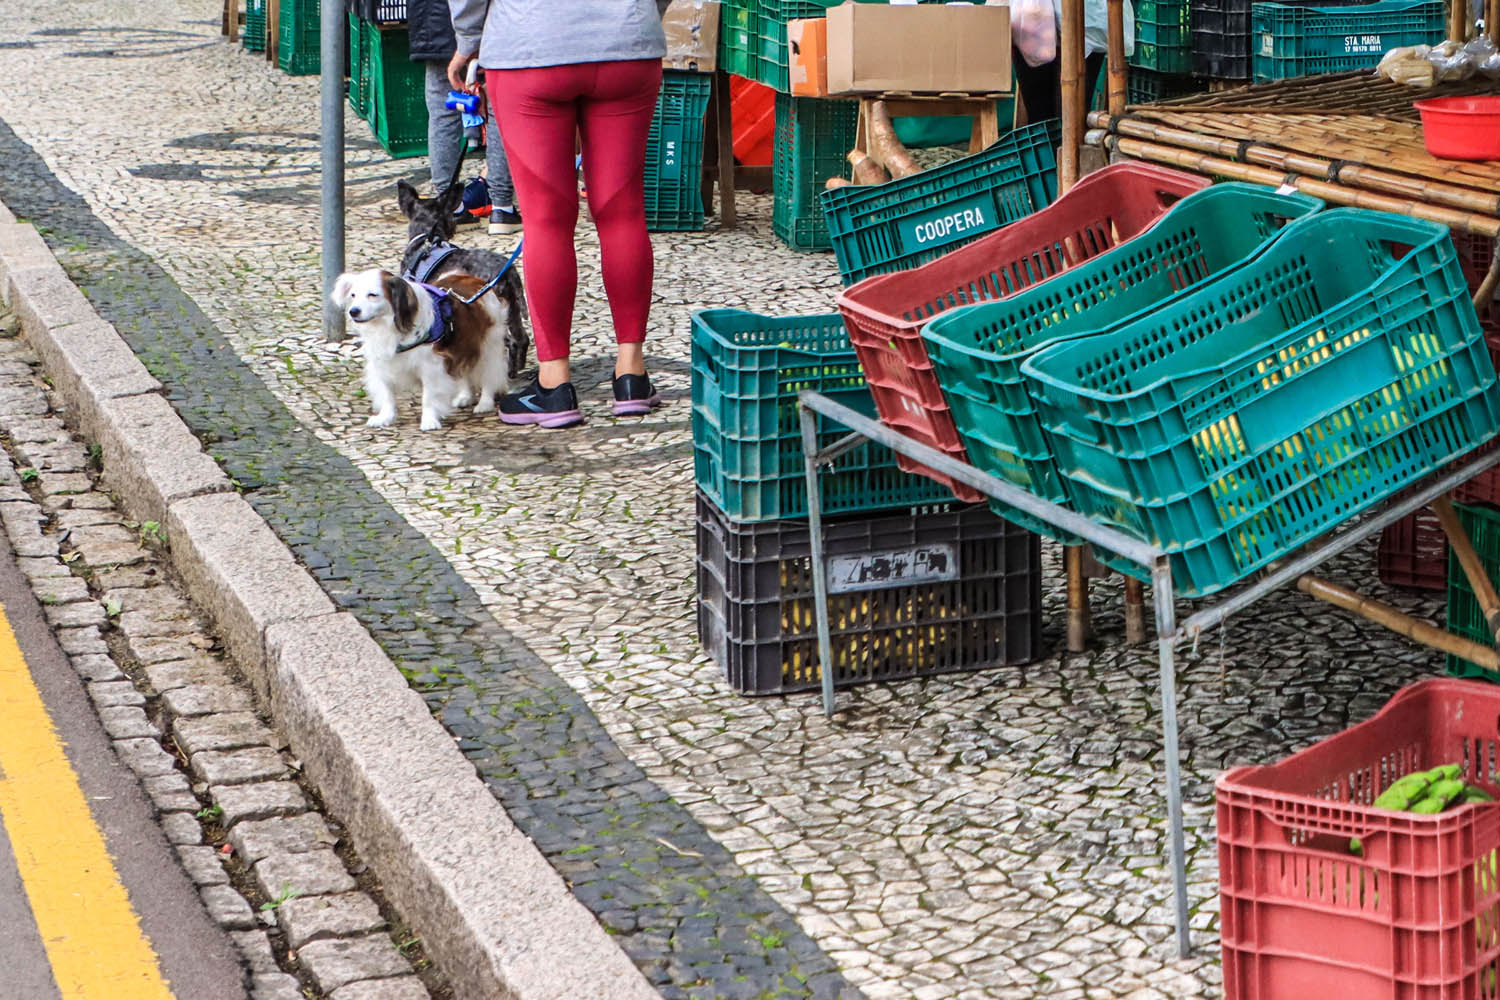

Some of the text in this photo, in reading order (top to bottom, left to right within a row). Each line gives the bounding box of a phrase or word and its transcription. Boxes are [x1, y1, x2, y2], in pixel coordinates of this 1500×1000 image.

[1361, 35, 1381, 46] MARIA
[665, 140, 676, 166] MKS
[914, 206, 985, 244] COOPERA
